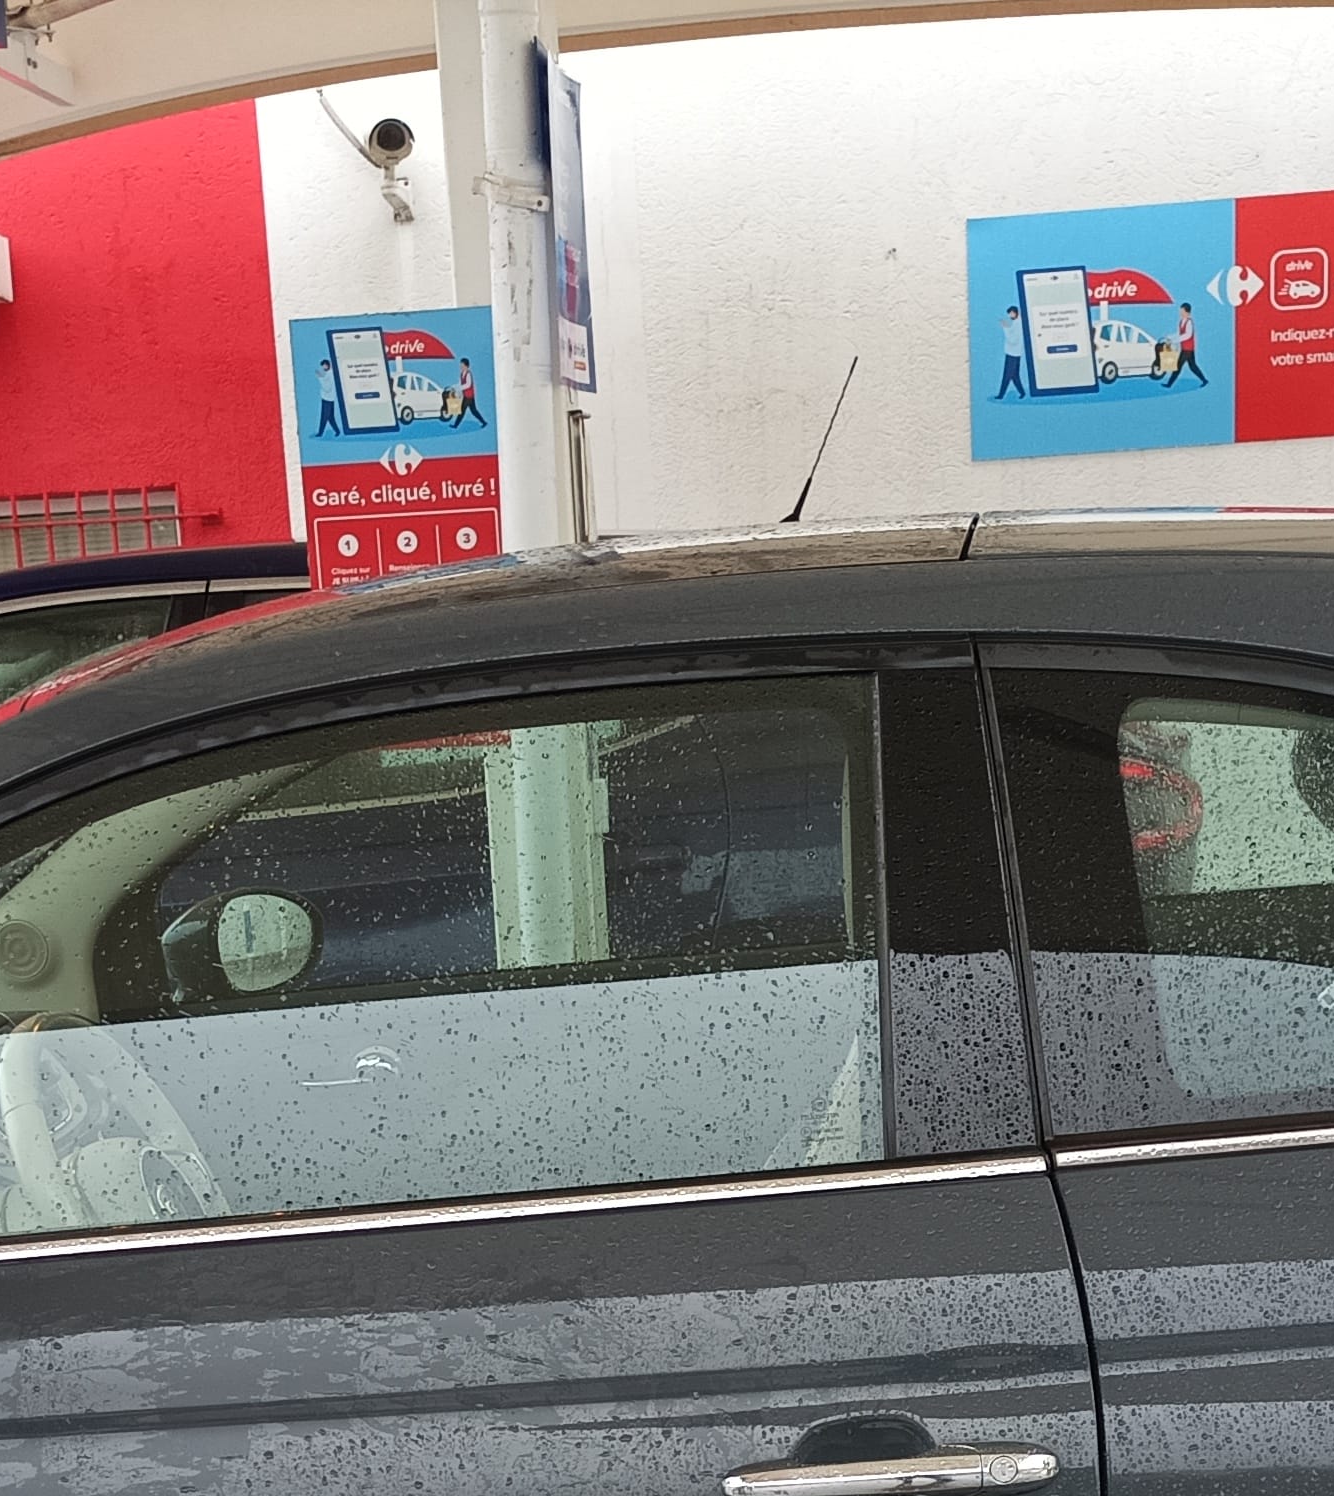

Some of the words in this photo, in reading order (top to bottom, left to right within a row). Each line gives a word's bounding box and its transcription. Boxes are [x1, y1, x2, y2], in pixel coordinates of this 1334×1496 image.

[1094, 280, 1138, 298] drive
[390, 339, 425, 354] drive
[1270, 353, 1304, 366] votre
[312, 486, 366, 507] Garé,
[371, 481, 437, 505] cliqué,
[441, 478, 485, 499] livré
